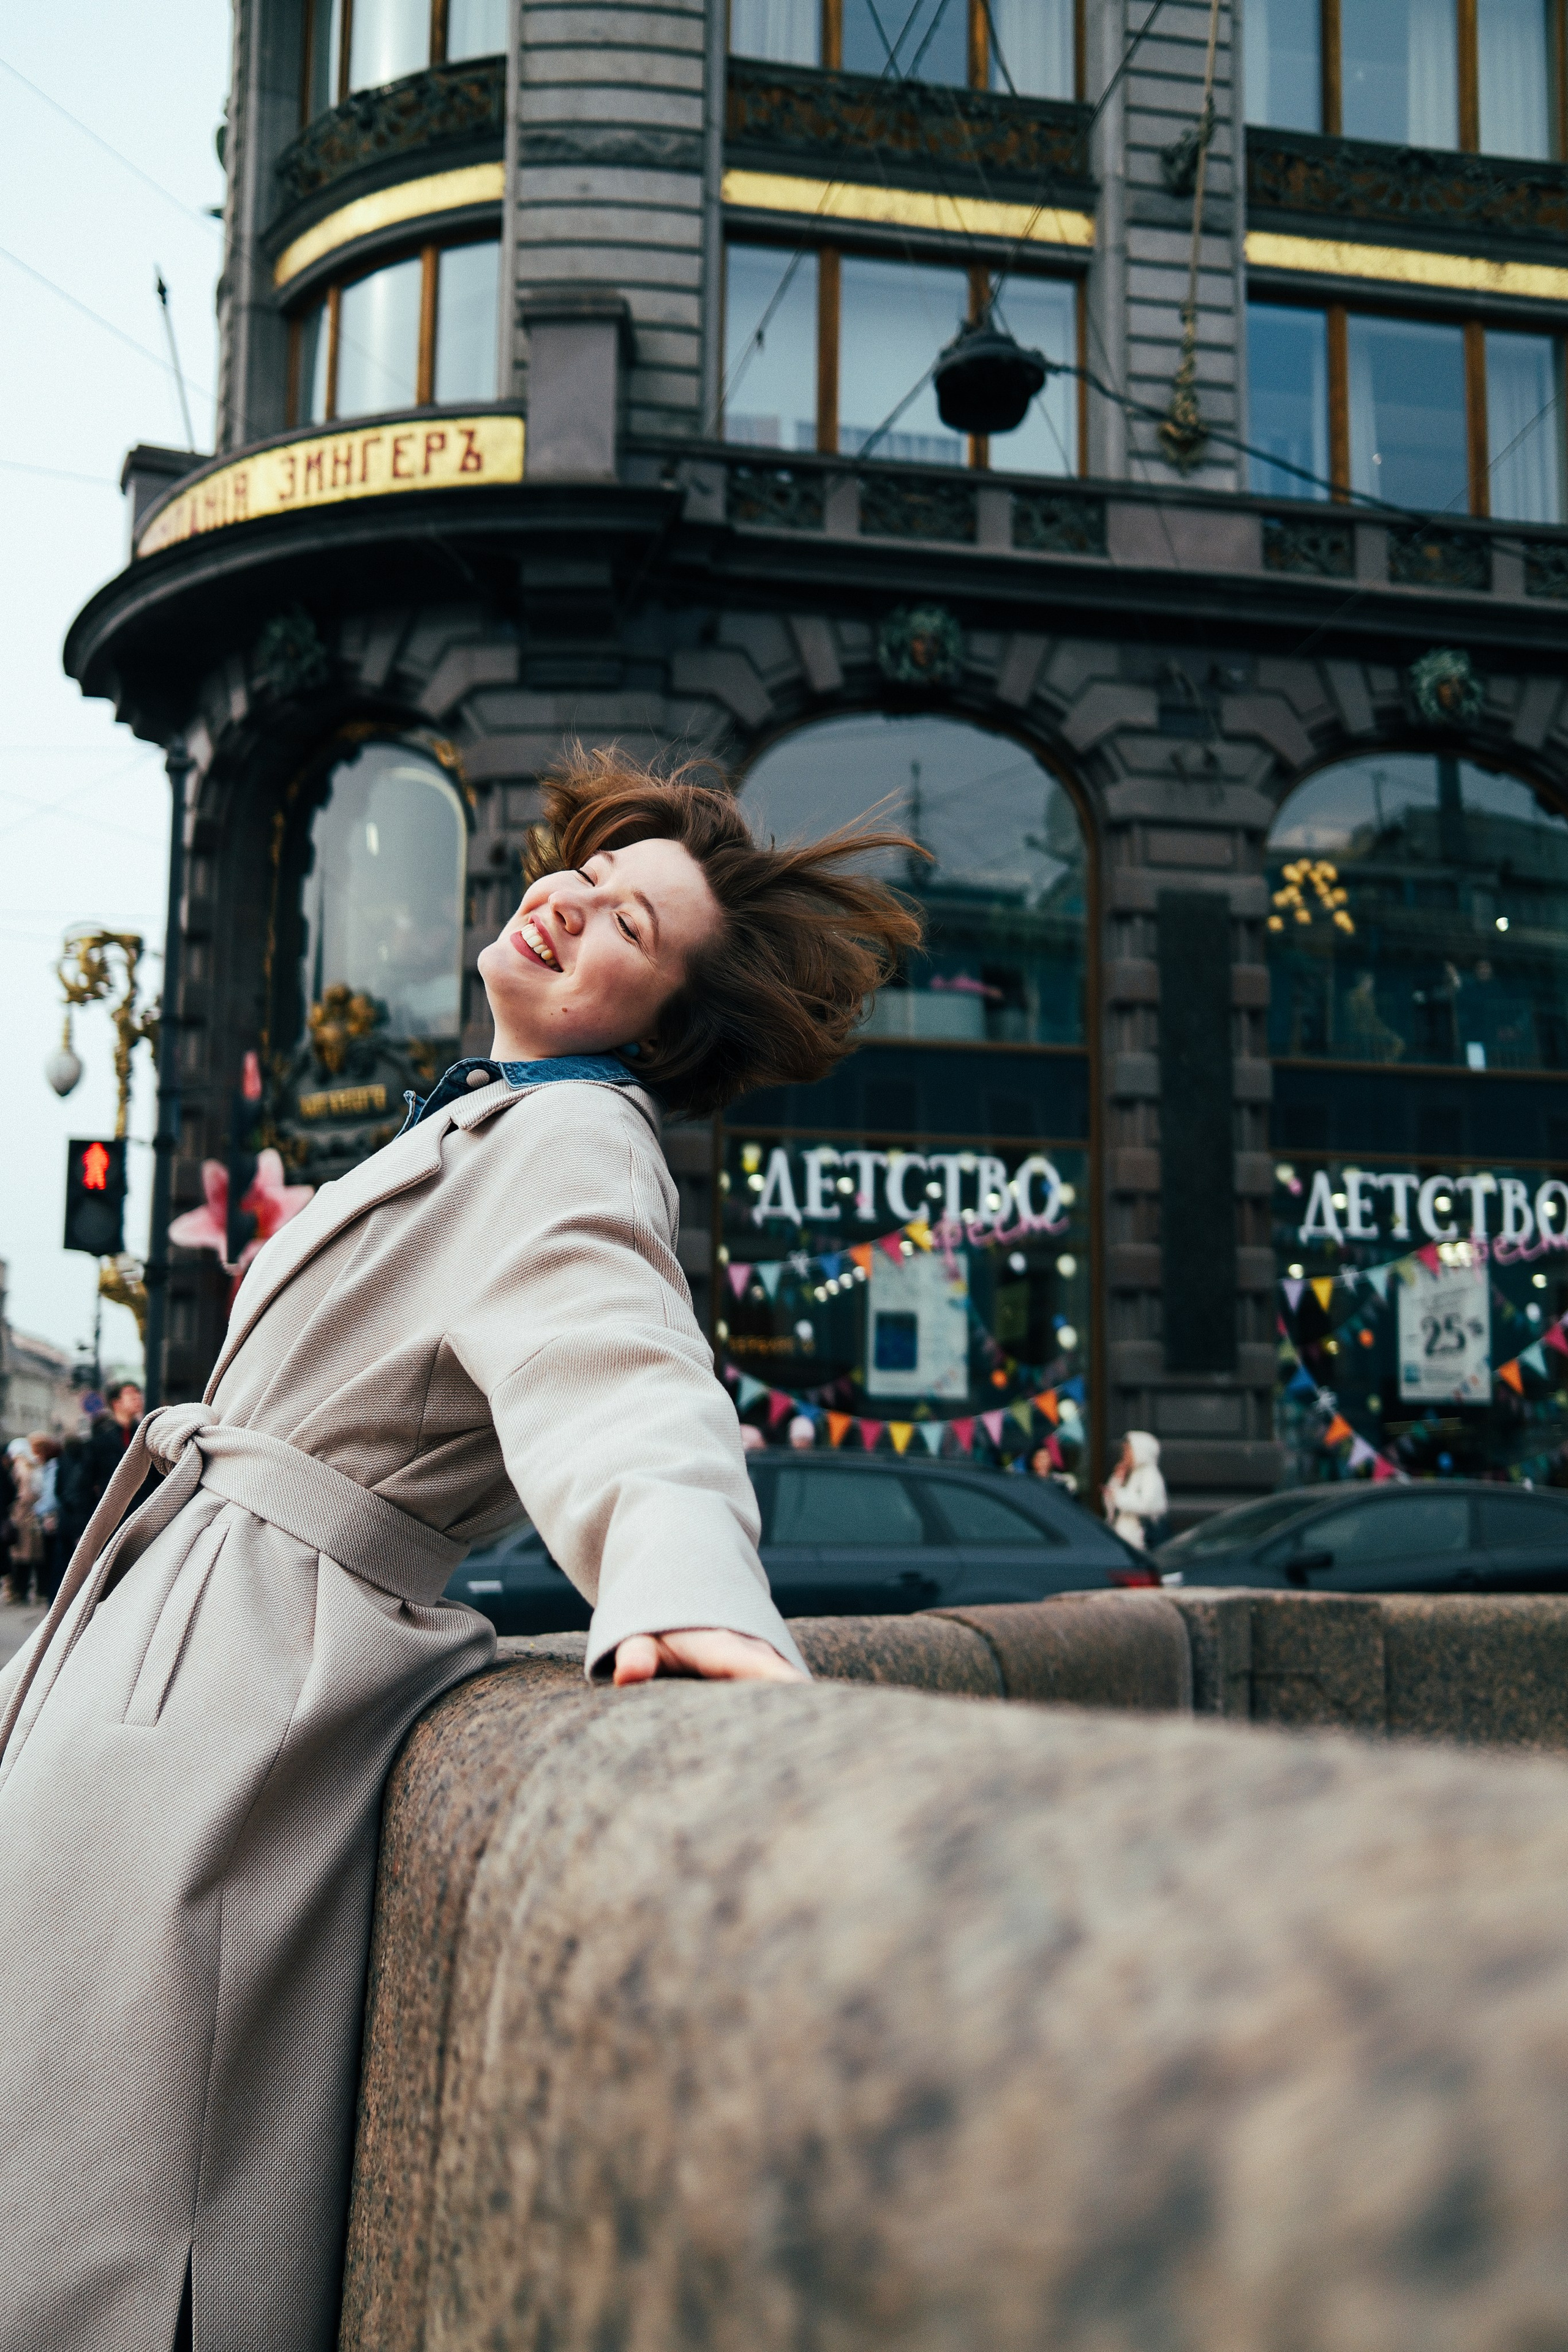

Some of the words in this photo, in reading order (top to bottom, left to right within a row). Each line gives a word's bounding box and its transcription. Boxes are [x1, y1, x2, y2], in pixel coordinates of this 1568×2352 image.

[279, 429, 484, 500] ЗИНГЕРЪ
[752, 1147, 1062, 1227] ДЕТСТВО
[1298, 1170, 1568, 1247] ДЕТСТВО
